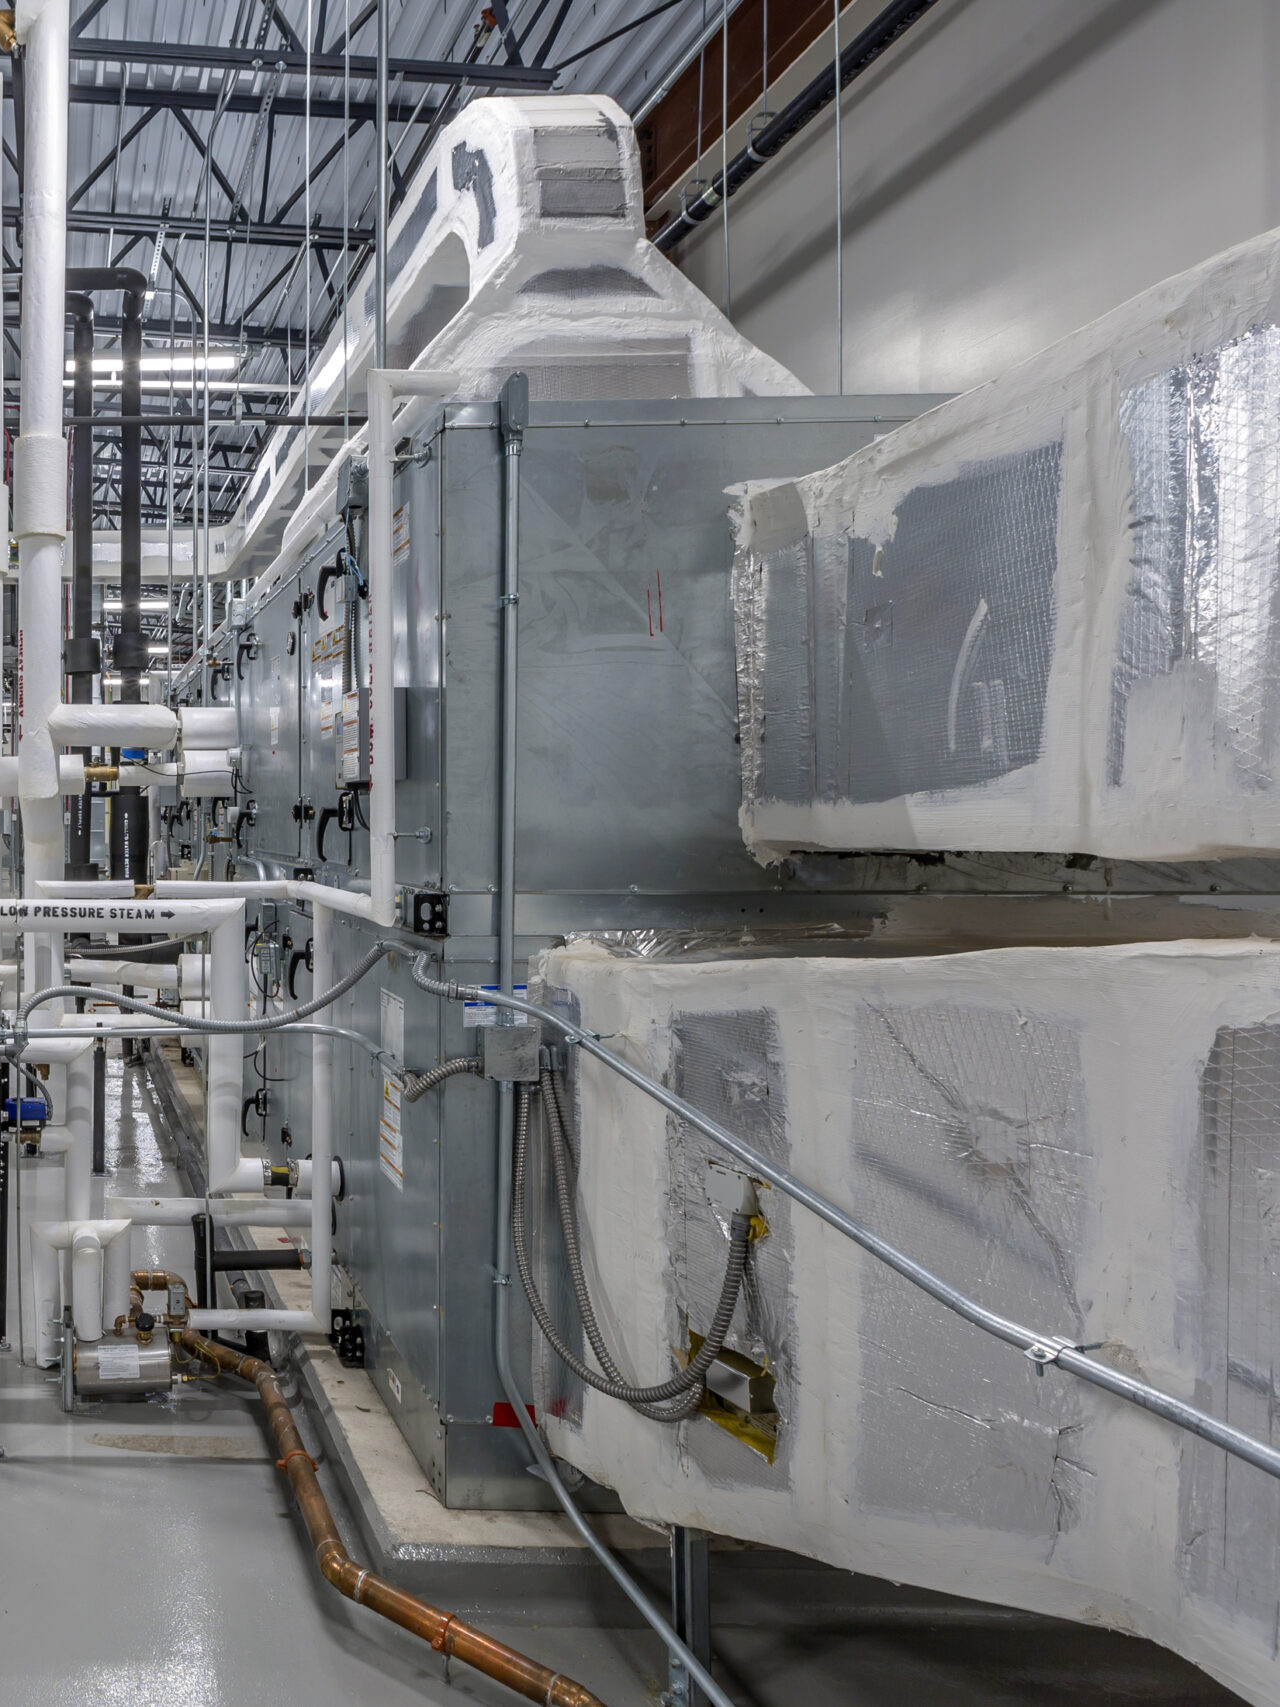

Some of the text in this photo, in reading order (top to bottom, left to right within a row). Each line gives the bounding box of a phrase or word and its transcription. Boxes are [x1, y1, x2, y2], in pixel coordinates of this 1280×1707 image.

[0, 906, 155, 920] LOW PRESSURE STEAM
